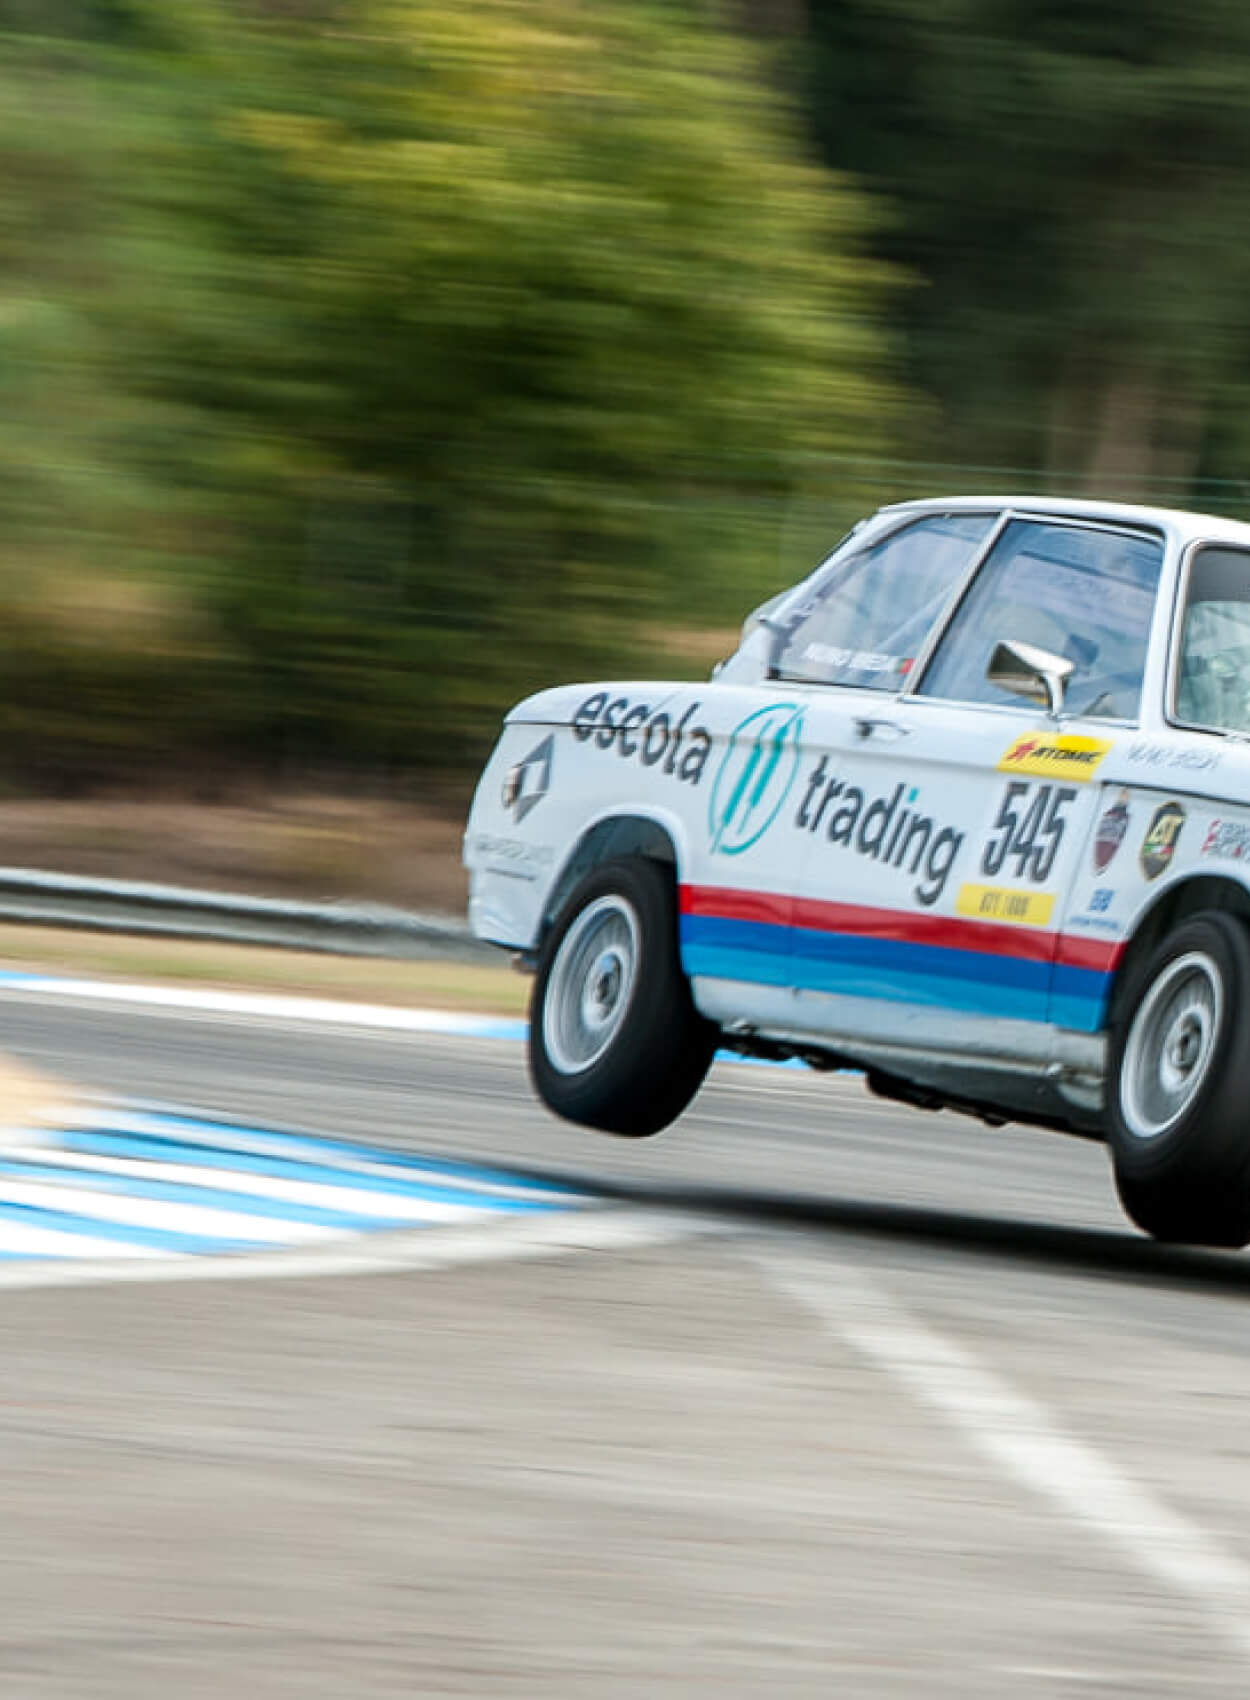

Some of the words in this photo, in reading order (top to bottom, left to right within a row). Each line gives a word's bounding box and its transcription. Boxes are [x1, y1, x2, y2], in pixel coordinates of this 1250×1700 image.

[573, 692, 713, 785] escola
[795, 754, 966, 906] trading
[981, 781, 1078, 883] 545
